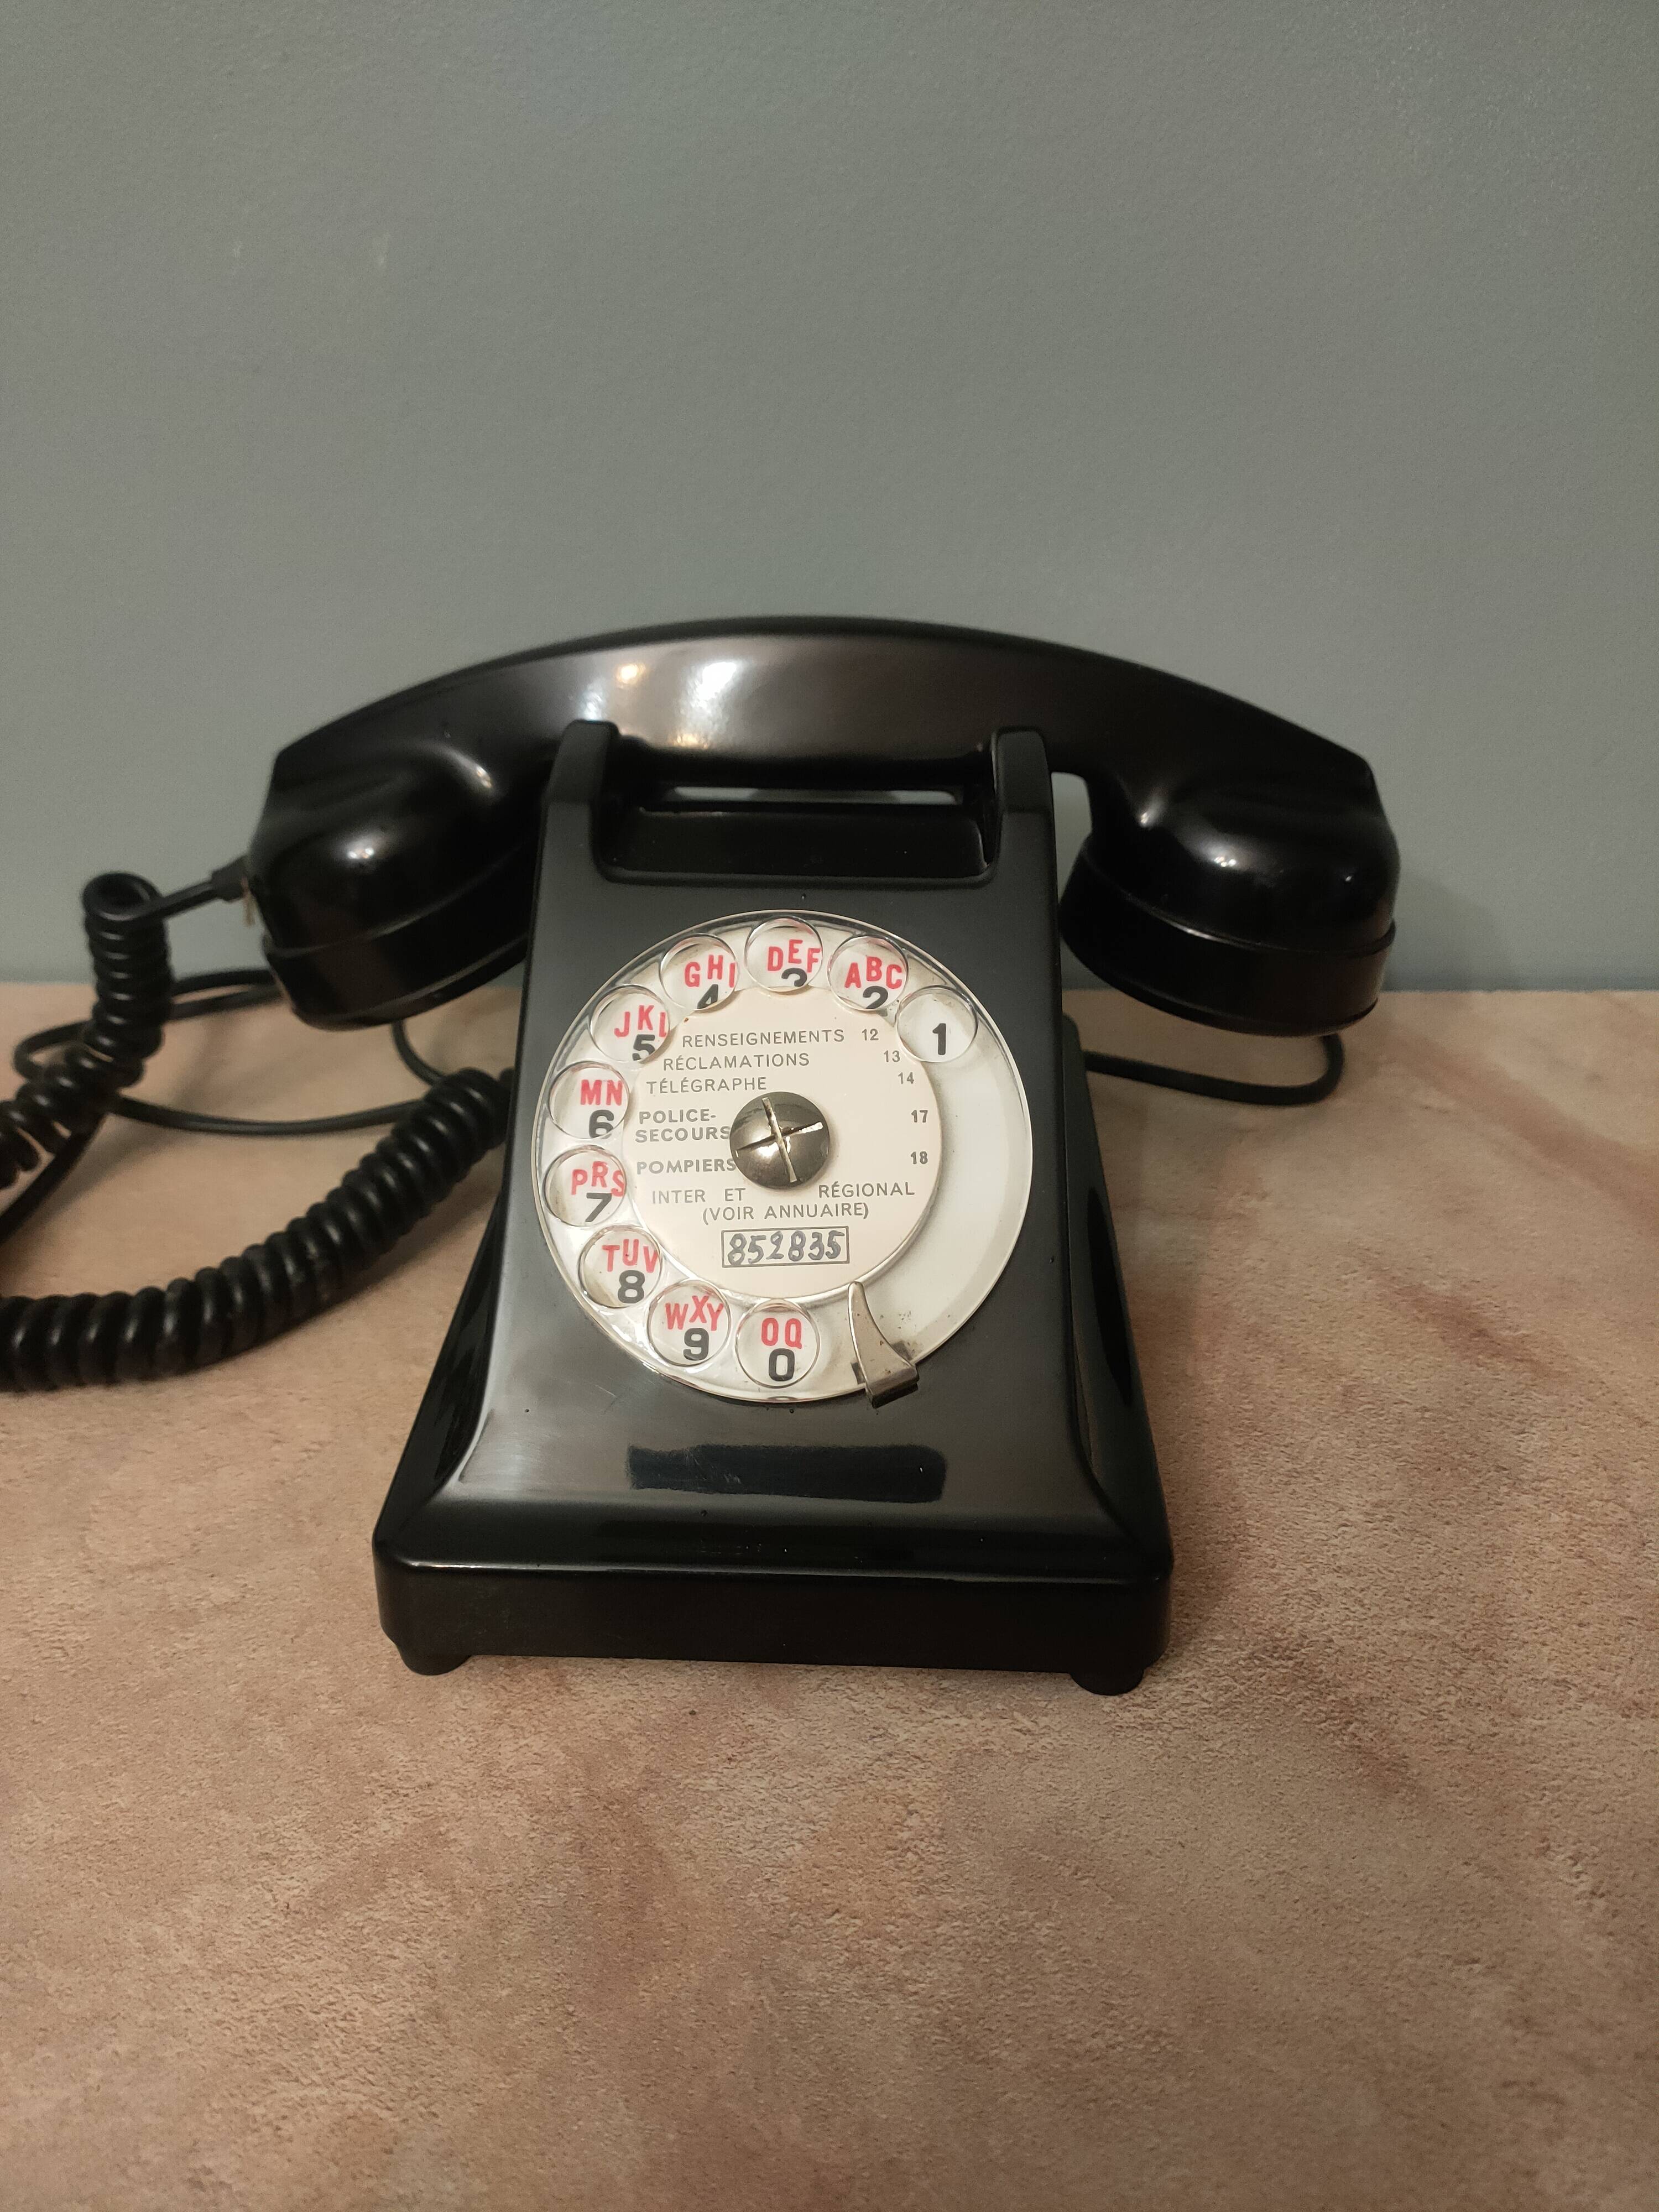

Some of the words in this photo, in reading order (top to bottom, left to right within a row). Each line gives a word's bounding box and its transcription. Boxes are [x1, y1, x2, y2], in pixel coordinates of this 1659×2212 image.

[684, 954, 736, 988] GHI
[768, 939, 821, 973] DEF
[844, 956, 903, 989] ABC
[862, 985, 889, 1010] 2
[632, 1034, 656, 1061] 5
[682, 1028, 845, 1047] RENSEIGNEMENTS
[862, 1028, 879, 1041] 12
[932, 1022, 947, 1056] 1
[662, 1052, 810, 1071] RÉCLAMATIONS
[883, 1050, 901, 1063] 13
[580, 1079, 623, 1107] MN
[646, 1076, 768, 1094] TÉLÉGRAPHE
[898, 1072, 915, 1085] 14
[588, 1109, 615, 1139] 6
[639, 1108, 717, 1125] POLICE-
[911, 1109, 928, 1123] 17
[634, 1125, 731, 1143] SECOURS
[636, 1158, 737, 1175] POMPIERS
[910, 1151, 928, 1165] 18
[571, 1161, 625, 1197] PRS
[652, 1189, 706, 1204] INTER
[724, 1187, 747, 1202] ET
[818, 1181, 916, 1199] RÉGIONAL
[585, 1192, 612, 1223] 7
[702, 1206, 755, 1225] (VOIR
[764, 1202, 869, 1220] ANNUAIRE)
[601, 1238, 660, 1274] TUV
[727, 1229, 846, 1265] 852835
[617, 1270, 645, 1304] 8
[665, 1295, 724, 1332] WXY
[682, 1327, 709, 1361] 9
[760, 1317, 802, 1349] OQ
